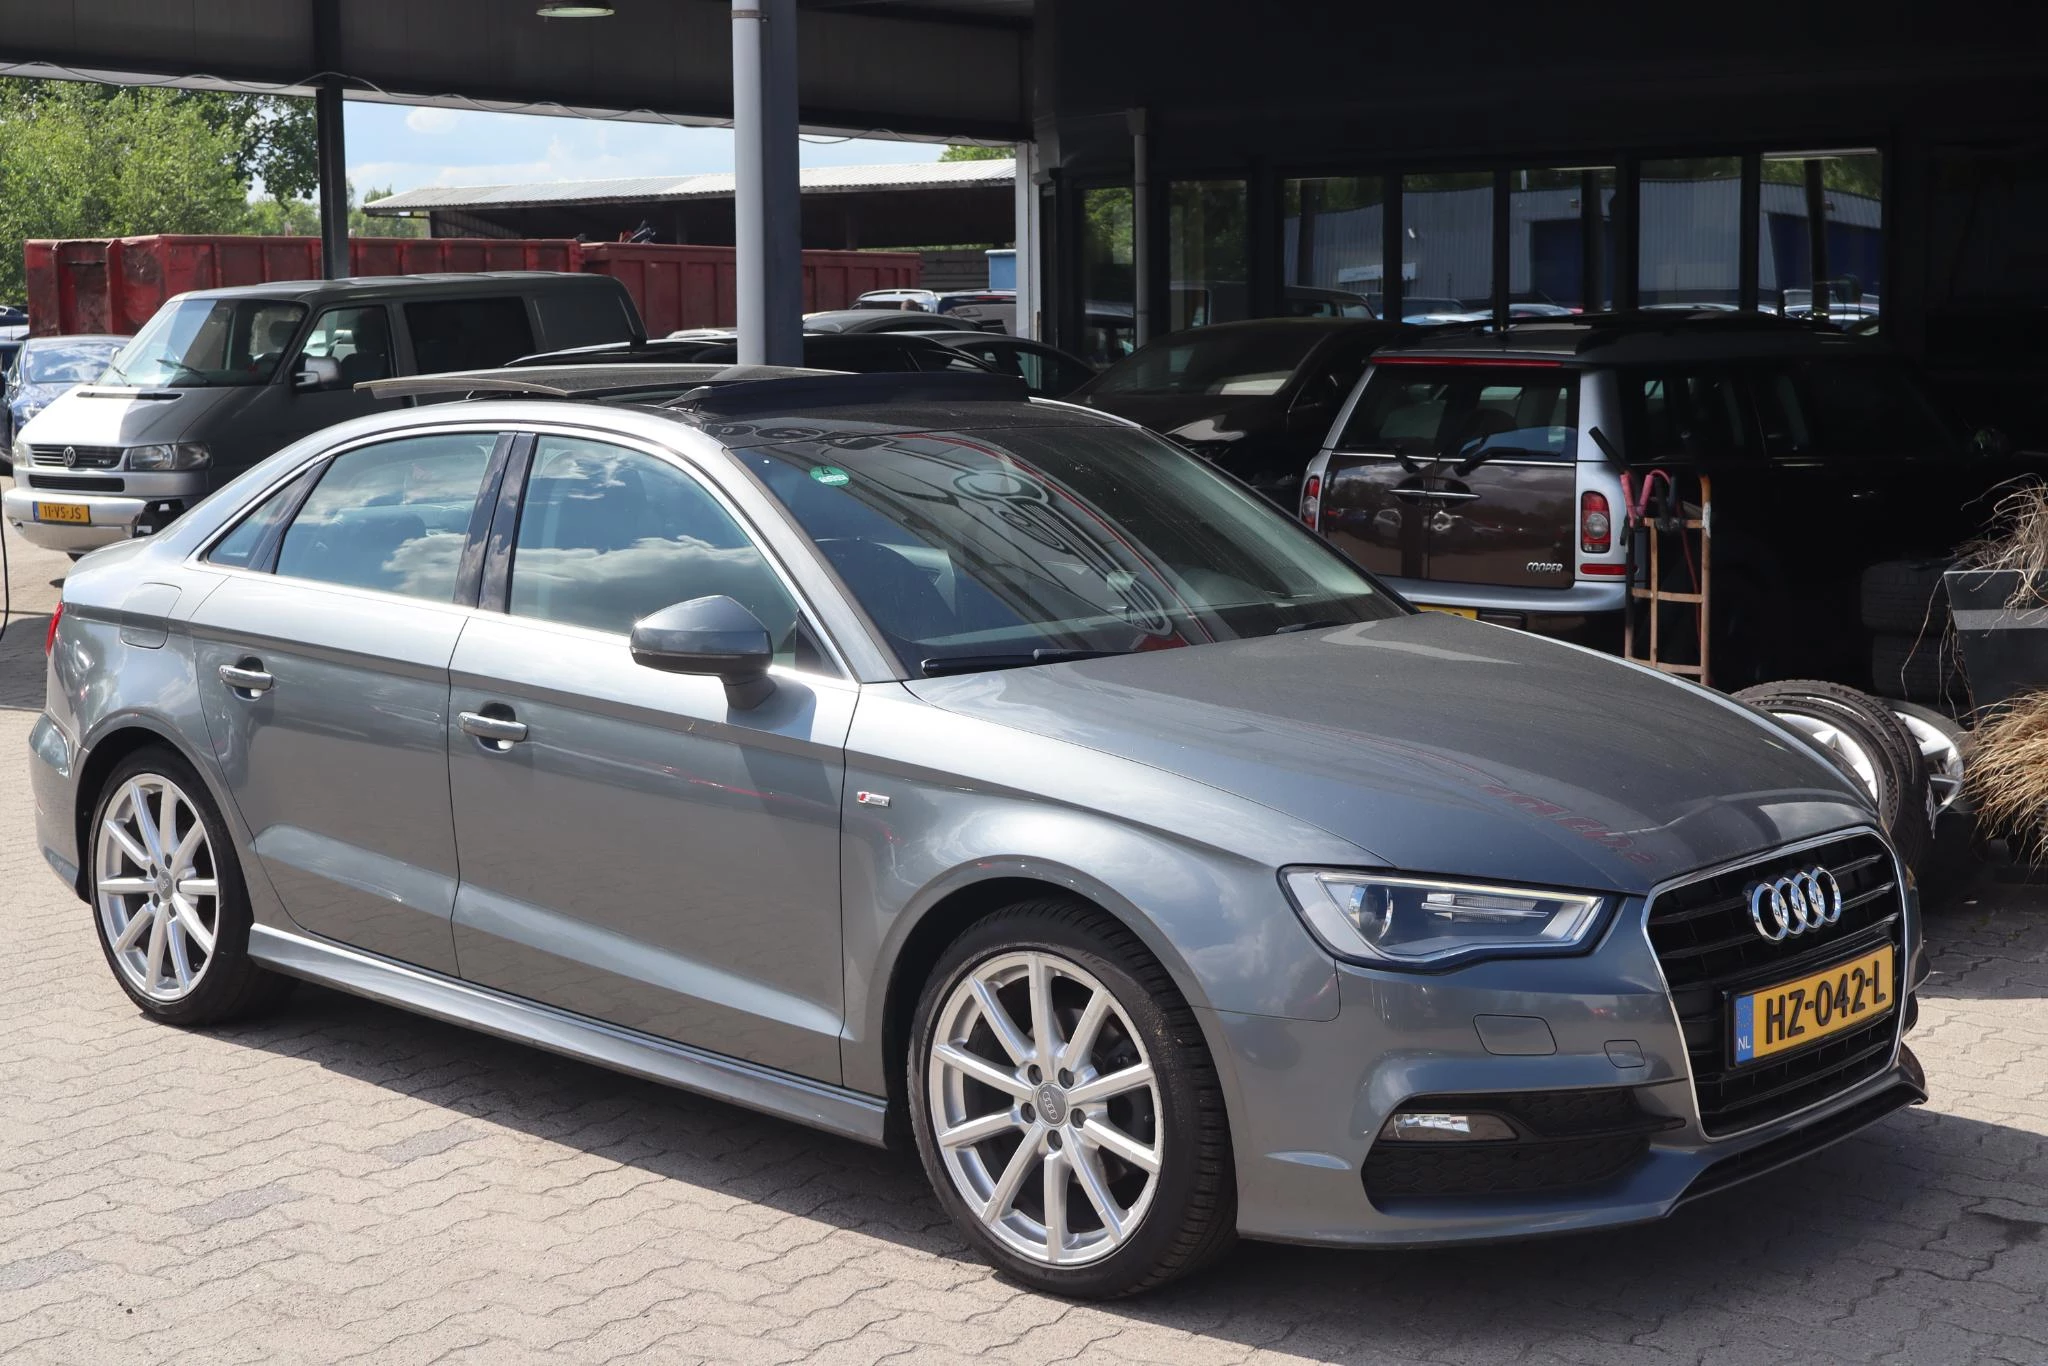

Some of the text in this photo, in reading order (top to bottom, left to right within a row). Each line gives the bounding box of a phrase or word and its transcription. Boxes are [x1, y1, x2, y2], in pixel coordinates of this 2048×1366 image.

[43, 505, 82, 519] 11-VS-JS
[1526, 562, 1563, 573] COOPER
[1766, 960, 1886, 1044] HZ-042-L
[1738, 1036, 1752, 1051] NL
